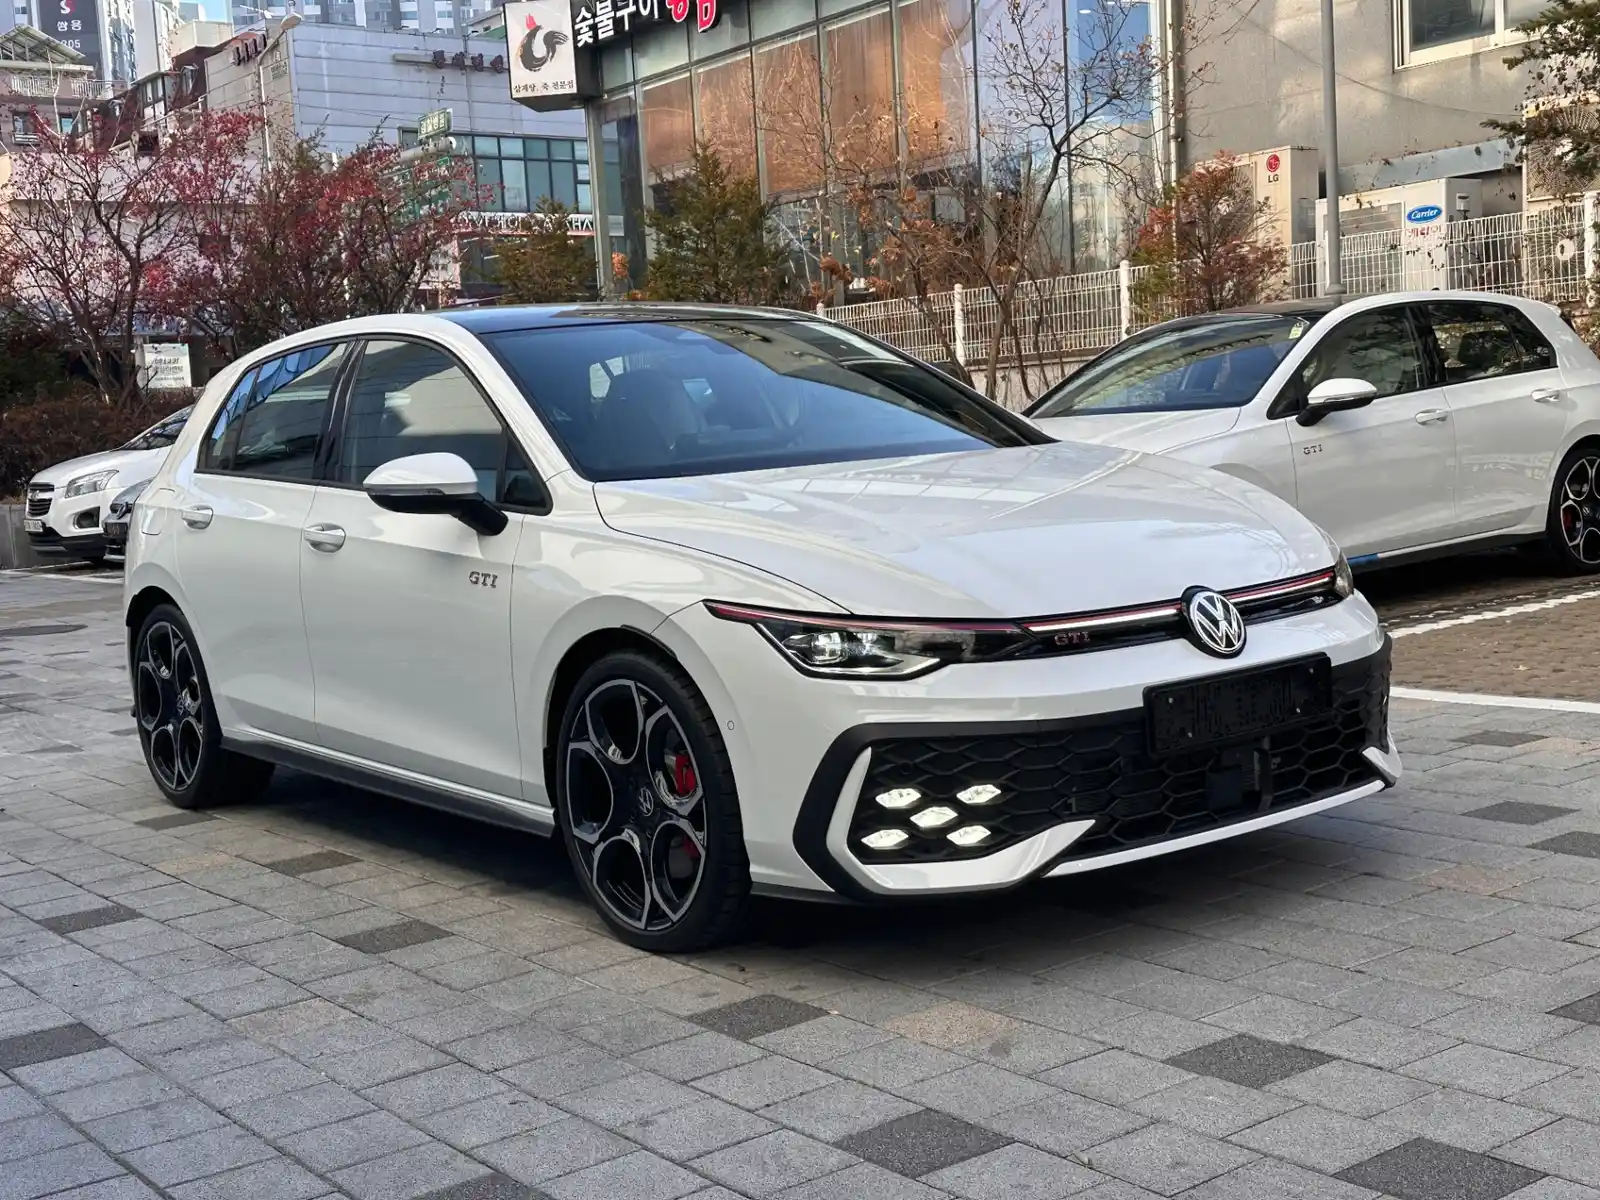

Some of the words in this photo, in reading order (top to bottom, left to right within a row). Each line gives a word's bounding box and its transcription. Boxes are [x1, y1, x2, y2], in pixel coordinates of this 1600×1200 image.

[1267, 173, 1279, 184] LG
[1411, 208, 1438, 220] Carrier
[1302, 443, 1323, 456] GTI
[468, 570, 499, 589] GTI
[1054, 631, 1091, 646] GTI
